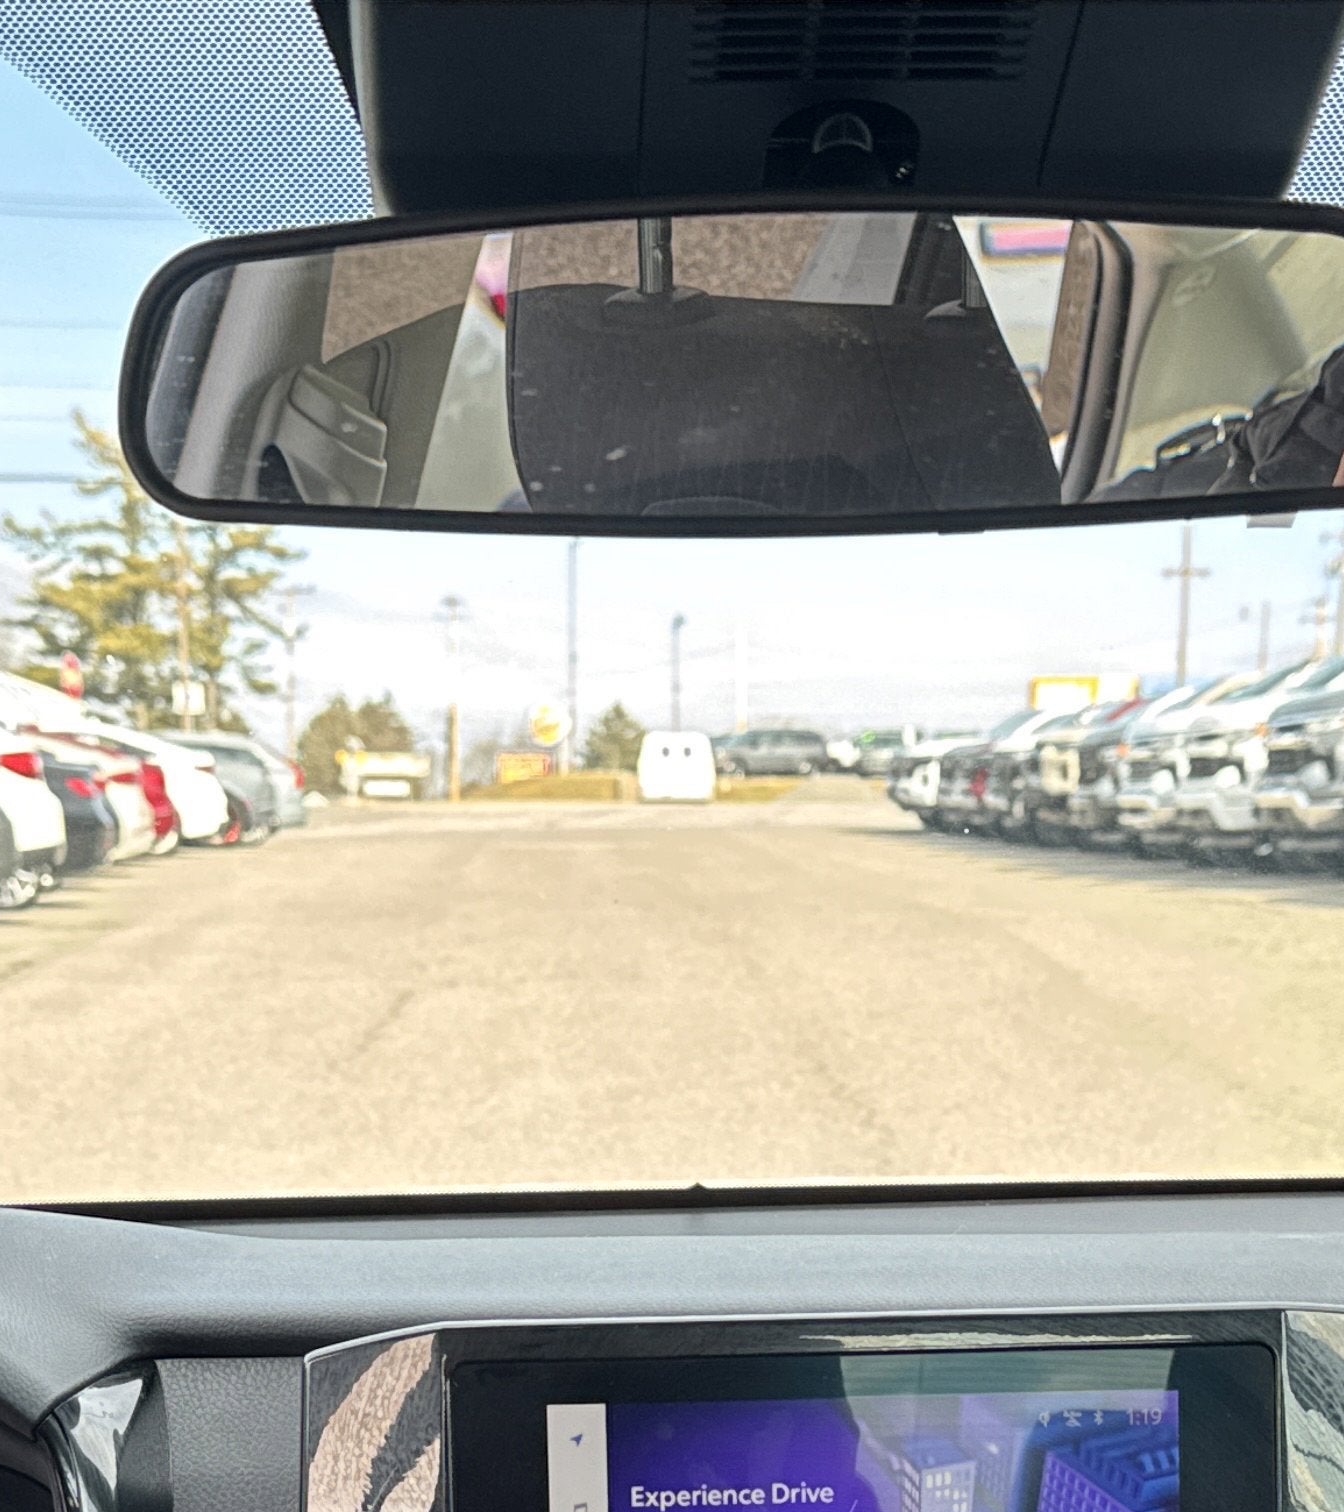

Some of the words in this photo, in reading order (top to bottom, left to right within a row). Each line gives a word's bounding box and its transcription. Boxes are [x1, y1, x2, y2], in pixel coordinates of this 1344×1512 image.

[1125, 1408, 1163, 1425] 1:19
[630, 1484, 765, 1512] Experience
[771, 1482, 835, 1505] Drive
